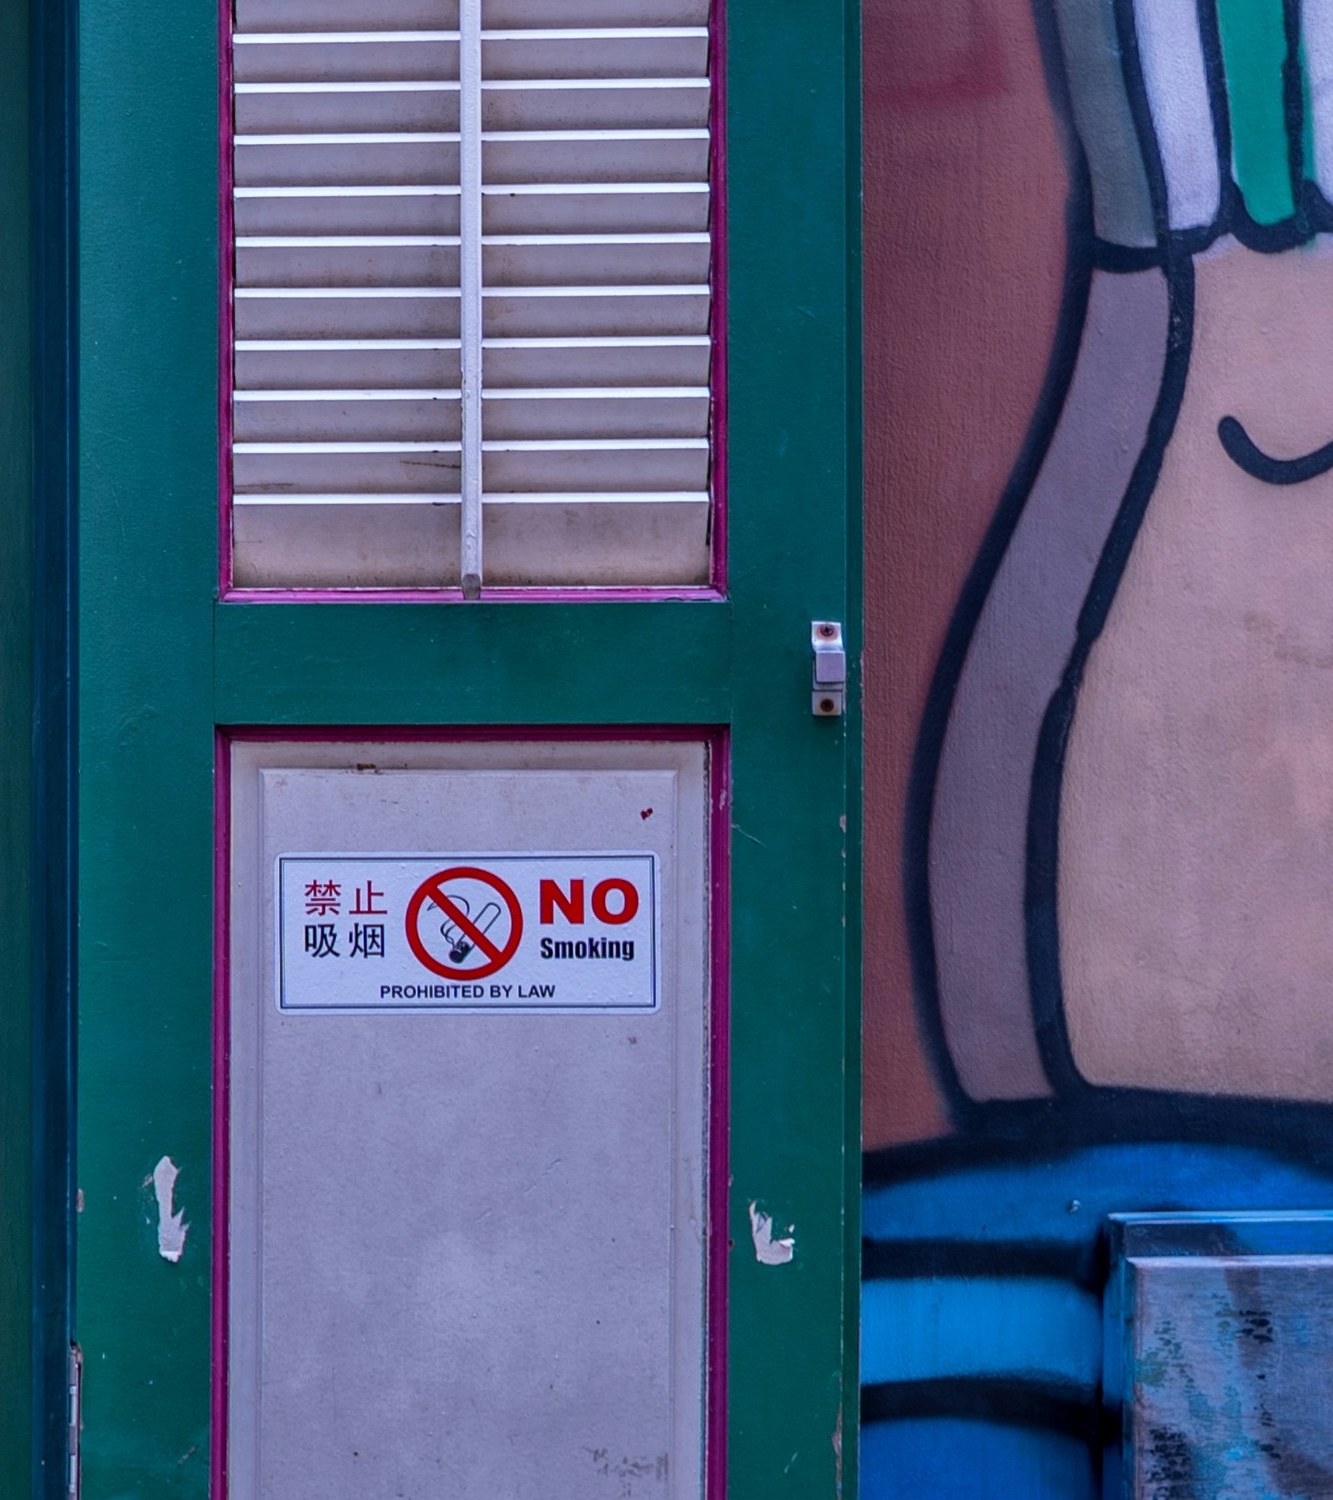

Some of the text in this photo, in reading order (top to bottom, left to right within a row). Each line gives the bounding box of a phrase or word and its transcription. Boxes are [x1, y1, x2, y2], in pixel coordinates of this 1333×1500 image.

[304, 879, 388, 916] 禁止
[539, 878, 639, 925] NO
[304, 922, 386, 960] 吸烟
[540, 936, 635, 961] Smoking
[380, 984, 556, 999] PROHIBITED BY LAW
